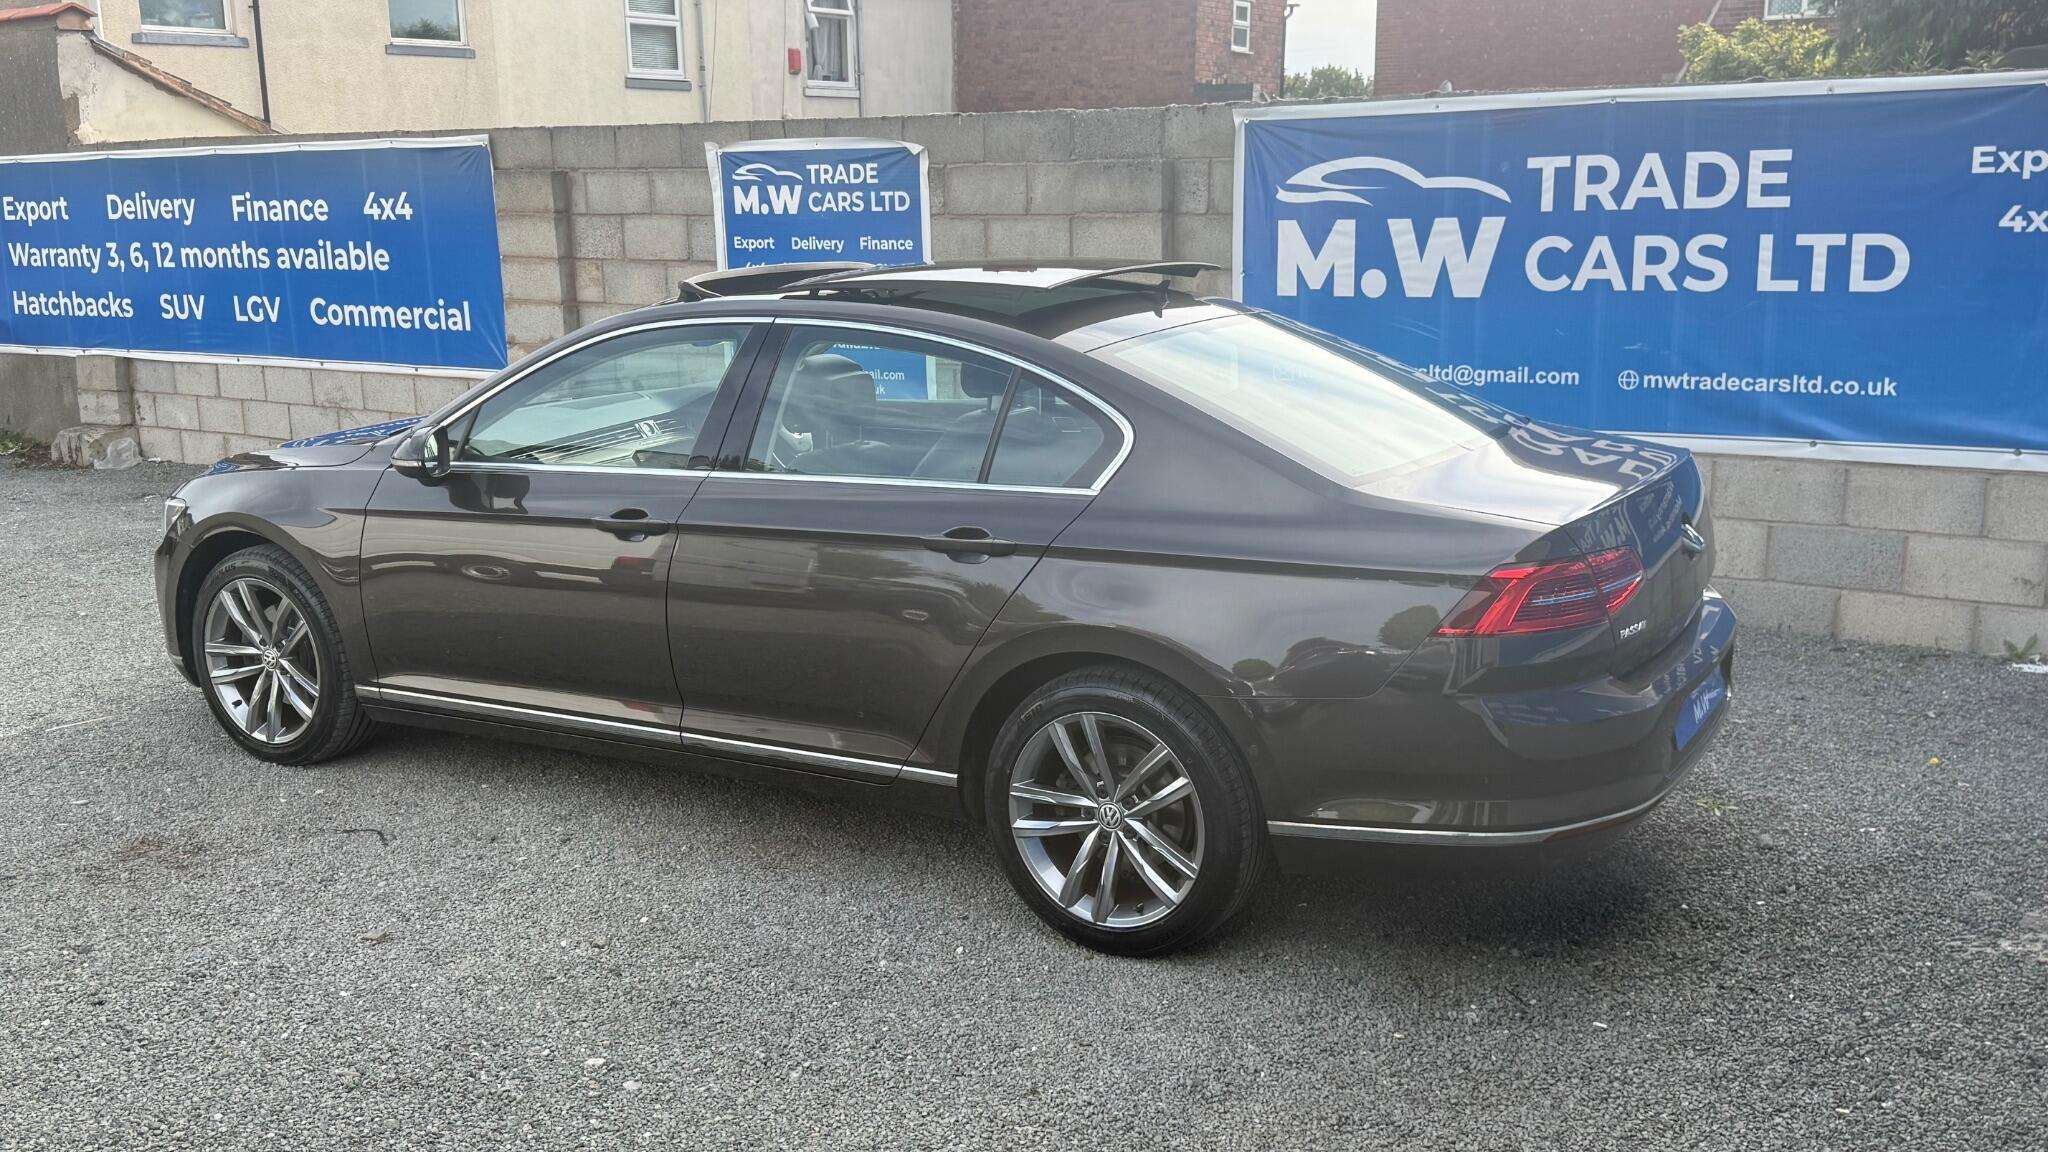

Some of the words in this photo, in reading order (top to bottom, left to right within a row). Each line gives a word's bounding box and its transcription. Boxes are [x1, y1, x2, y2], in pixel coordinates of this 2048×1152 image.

[806, 163, 878, 184] TRADE
[1527, 149, 1792, 211] TRADE
[3, 196, 69, 227] Export
[106, 191, 196, 226] Delivery
[231, 191, 329, 222] Finance
[363, 191, 413, 221] 4x4
[734, 184, 802, 215] M.W
[808, 191, 864, 213] CARS
[870, 191, 910, 212] LTD
[8, 243, 101, 274] Warranty
[106, 243, 125, 272] 3,
[129, 242, 149, 273] 6,
[153, 242, 176, 268] 12
[180, 241, 271, 269] months
[276, 240, 390, 271] available
[733, 236, 775, 251] Export
[791, 236, 845, 253] Delivery
[859, 235, 914, 251] Finance
[1276, 216, 1506, 298] M.W
[1525, 233, 1729, 292] CARS
[1757, 232, 1910, 292] LTD
[12, 291, 134, 318] Hatchbacks
[159, 294, 205, 320] SUV
[233, 295, 281, 323] LGV
[310, 297, 471, 331] Commercial
[1643, 372, 1897, 396] mwtradecarsltd.co.uk
